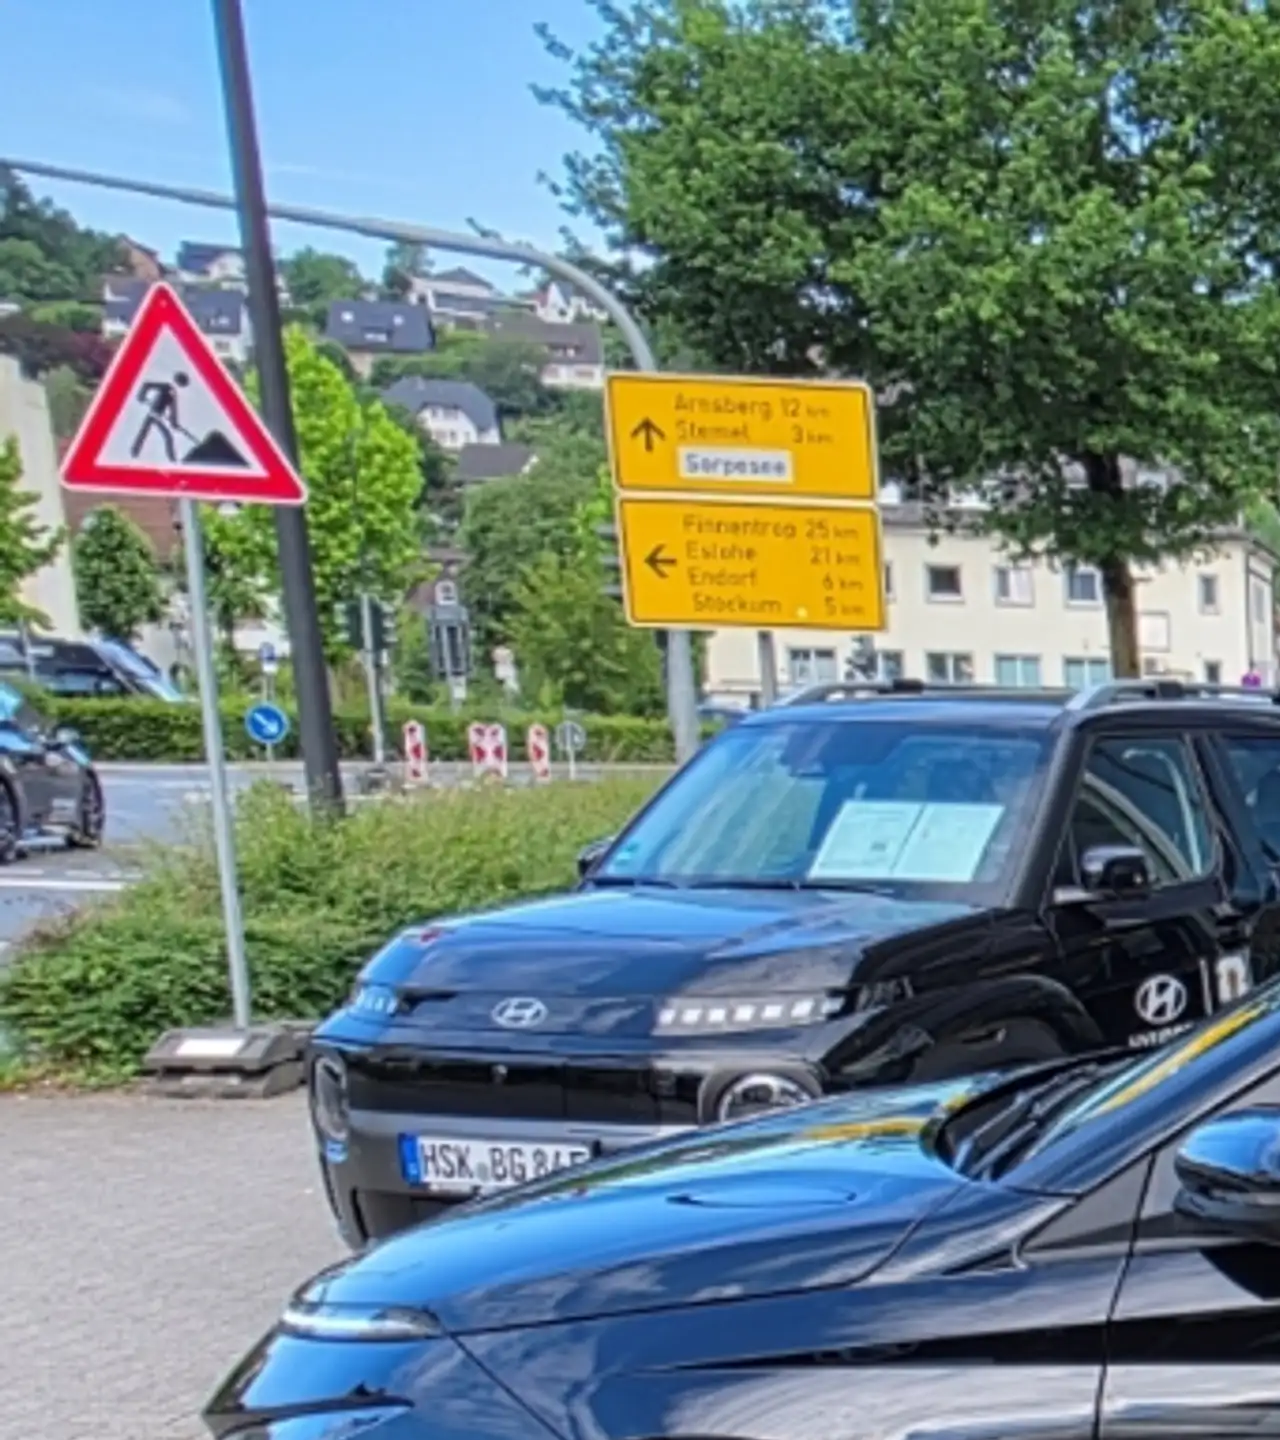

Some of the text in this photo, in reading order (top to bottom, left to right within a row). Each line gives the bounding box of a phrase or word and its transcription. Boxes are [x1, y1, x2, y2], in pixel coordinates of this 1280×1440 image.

[675, 393, 830, 420] Arnsberg 12 km
[792, 424, 803, 443] 3
[805, 518, 829, 539] 25
[834, 526, 858, 539] km
[811, 547, 830, 565] 21
[837, 552, 860, 565] km
[688, 567, 864, 590] Endorf 6 km
[693, 593, 782, 613] Stockum
[824, 596, 836, 615] 5
[421, 1143, 473, 1179] HSK
[490, 1148, 527, 1181] BG
